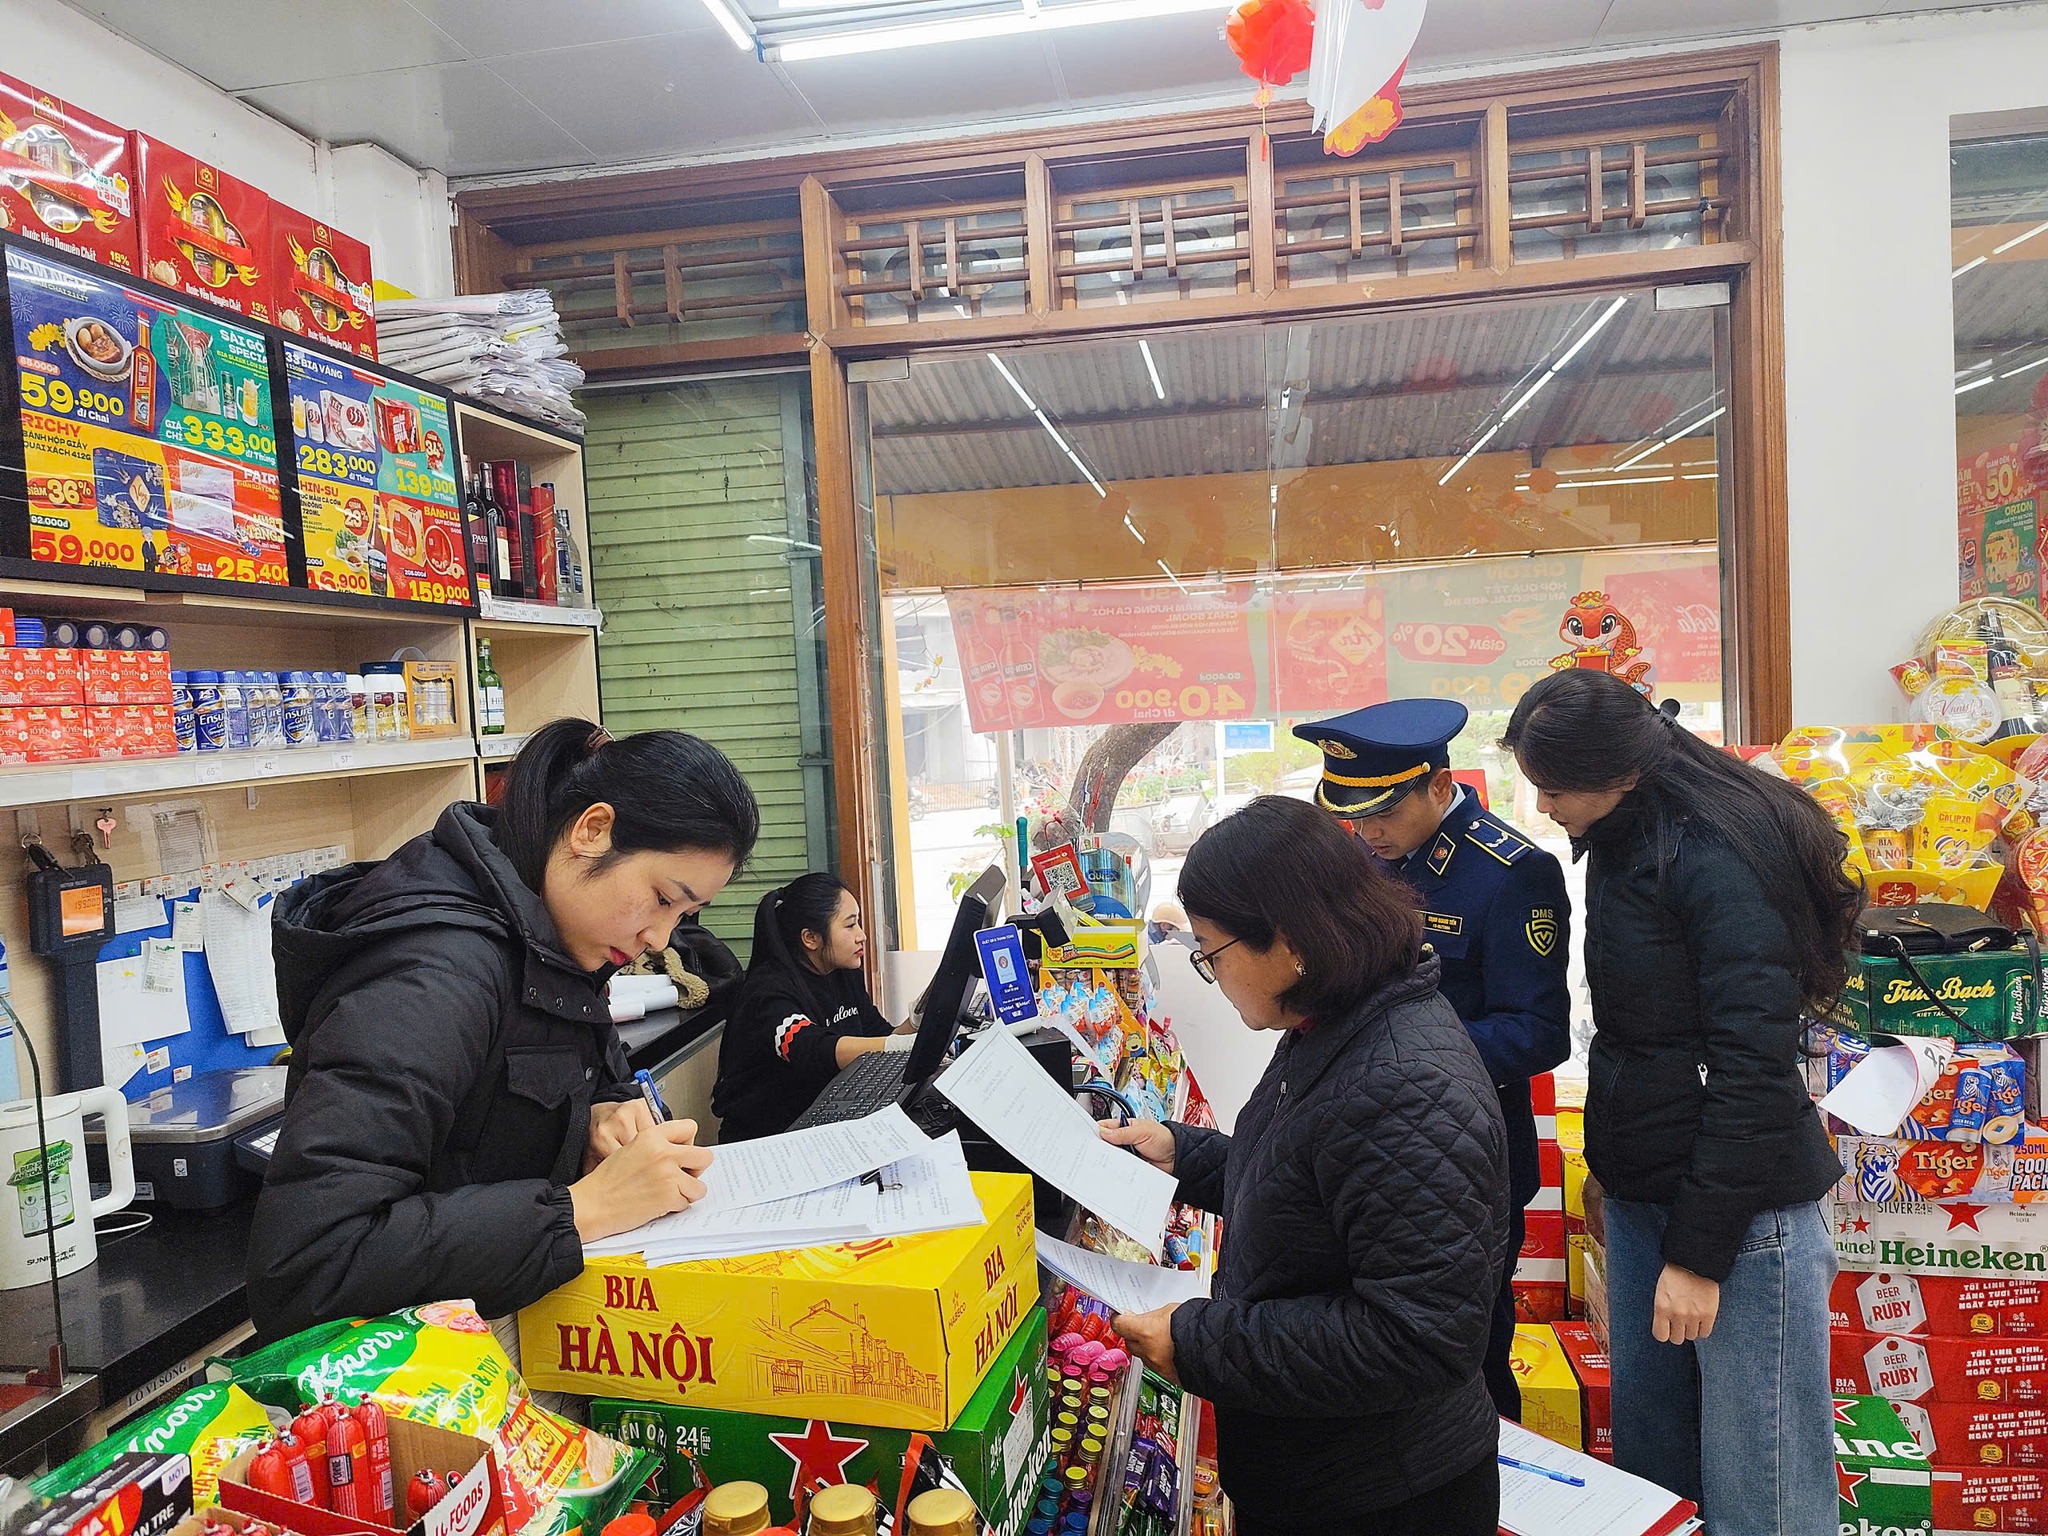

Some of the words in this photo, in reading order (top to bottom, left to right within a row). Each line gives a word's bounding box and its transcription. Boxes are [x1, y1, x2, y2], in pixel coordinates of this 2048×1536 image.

[252, 301, 268, 314] 13%
[220, 330, 246, 348] SÀI
[246, 340, 265, 354] GÒ
[228, 344, 268, 364] SPECIA
[301, 358, 318, 372] BIA
[319, 364, 343, 380] VÀNG
[21, 371, 124, 416] 59.900
[22, 412, 81, 438] RICHY
[88, 410, 110, 424] Chai
[47, 444, 70, 456] XÁCH
[300, 445, 376, 478] 283.000
[47, 478, 92, 504] 36%
[396, 468, 456, 497] 139.000
[424, 506, 448, 520] BÁNH
[2004, 502, 2033, 516] ORION
[31, 515, 68, 528] 92.000đ
[32, 530, 134, 564] 59.000
[409, 580, 470, 604] 159.000
[285, 706, 312, 720] nsure
[1878, 838, 1892, 846] BIA
[1885, 847, 1905, 860] NỘI
[1531, 909, 1554, 920] DMS
[1938, 975, 1996, 1002] Bạch
[2015, 1144, 2048, 1155] 250ML
[1912, 1148, 1978, 1180] Tiger
[2010, 1176, 2048, 1192] PACK
[1877, 1202, 1913, 1214] SILVER
[1914, 1204, 1926, 1212] 24
[1880, 1240, 2046, 1272] Heineken
[984, 1244, 1006, 1292] BIA
[604, 1274, 659, 1313] BIA
[1876, 1286, 1900, 1299] BEER
[1829, 1312, 1848, 1320] BIA
[1872, 1300, 1912, 1322] RUBY
[974, 1312, 995, 1379] HÀ
[995, 1282, 1018, 1338] NỘI
[297, 1327, 411, 1399] Knorr
[557, 1314, 621, 1376] HÀ
[630, 1322, 718, 1394] NỘI
[1884, 1354, 1908, 1366] BEER
[144, 1380, 158, 1399] VI
[157, 1362, 187, 1391] SÓNG
[1836, 1378, 1856, 1387] BIA
[1880, 1366, 1919, 1388] RUBY
[506, 1413, 532, 1446] MUA
[676, 1426, 699, 1447] 24
[525, 1428, 554, 1471] ẶNG
[152, 1503, 174, 1530] TRE
[449, 1480, 484, 1531] FOODS
